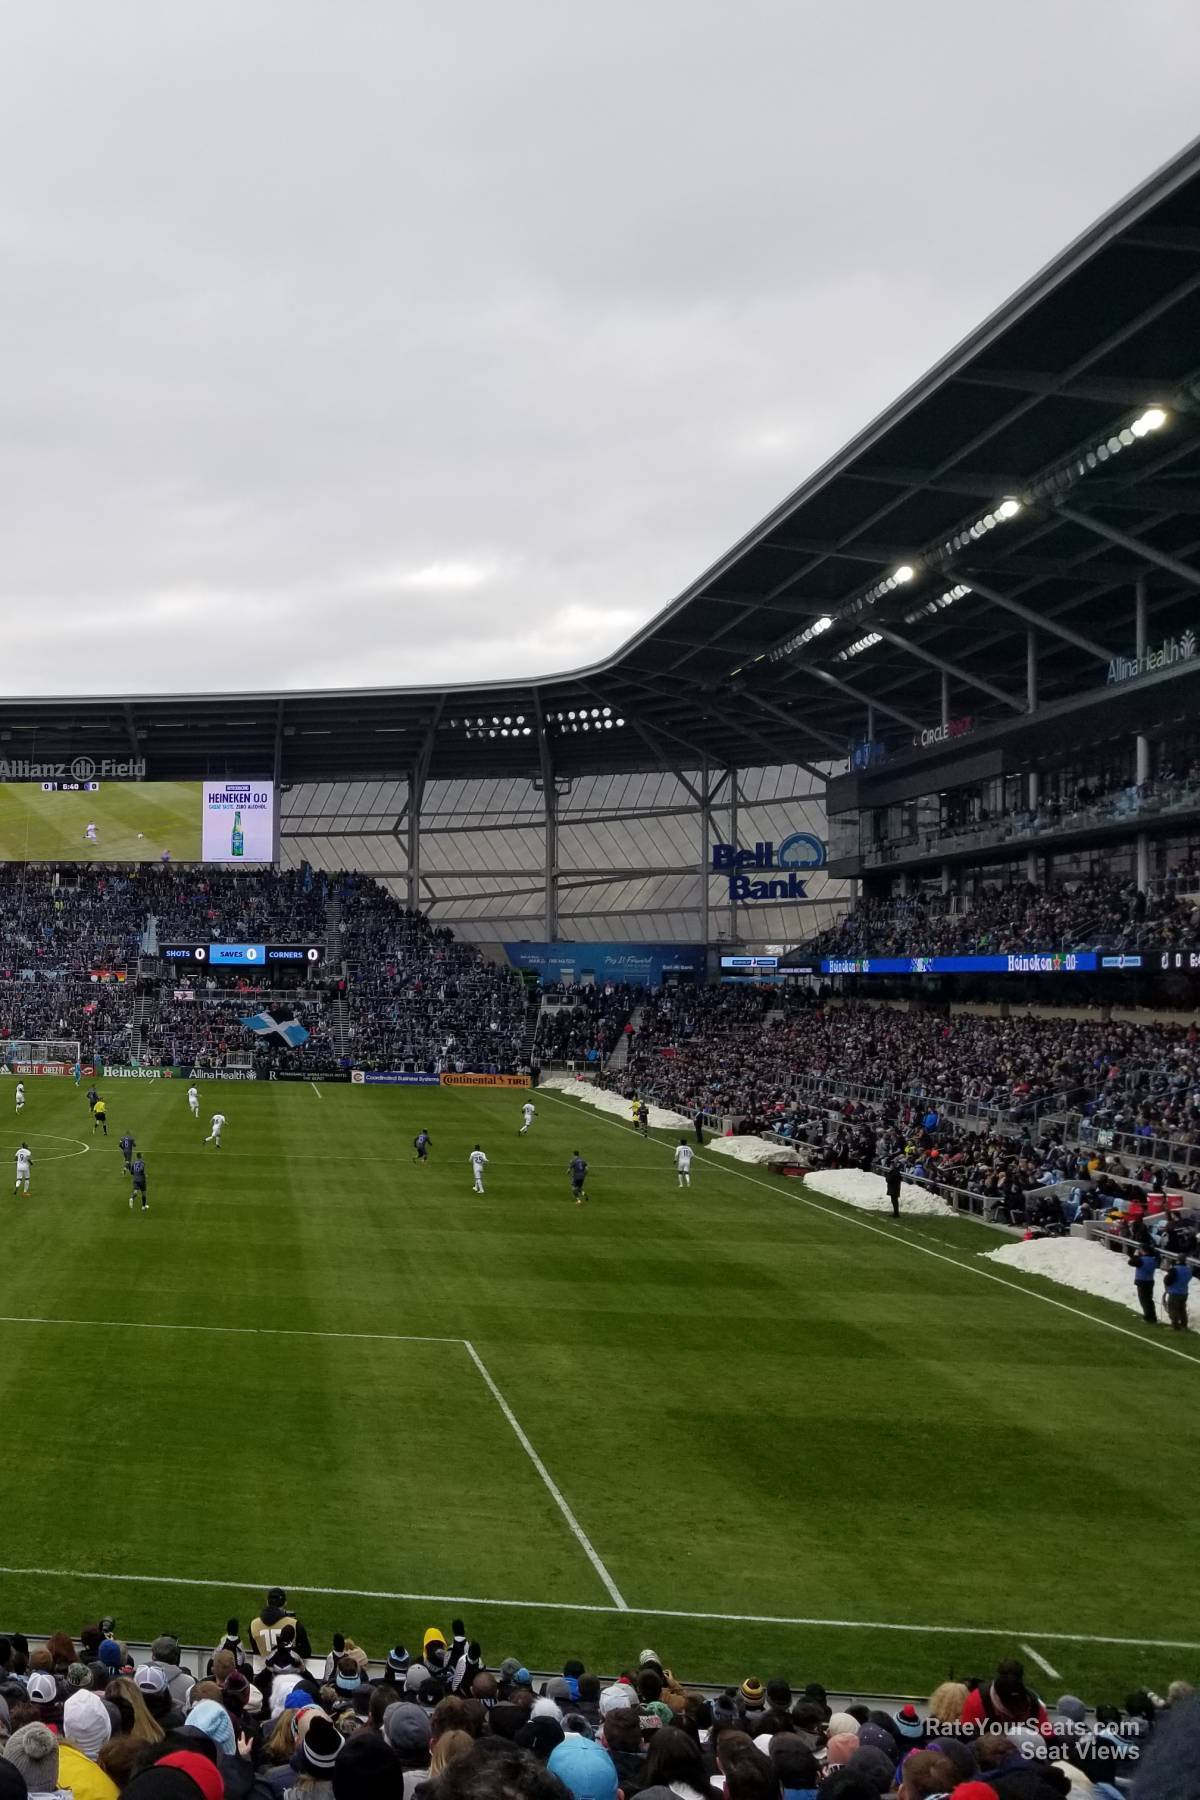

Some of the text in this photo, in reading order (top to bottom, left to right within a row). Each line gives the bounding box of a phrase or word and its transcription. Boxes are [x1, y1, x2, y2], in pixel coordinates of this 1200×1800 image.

[1106, 637, 1179, 685] Allina Health
[921, 724, 949, 746] CIRCLE
[102, 759, 146, 777] Field
[208, 793, 268, 803] HEINEKEN 0.0
[712, 842, 773, 869] Bell
[729, 873, 809, 900] Bank
[195, 948, 205, 959] 0
[246, 948, 257, 960] 0
[269, 949, 318, 960] CORNERS 0
[829, 961, 855, 973] Heineken
[1008, 955, 1052, 971] Heineken
[103, 1067, 161, 1078] Heineken
[189, 1068, 246, 1080] Allina Health
[269, 1070, 278, 1080] R
[442, 1074, 496, 1086] Continental
[19, 1153, 24, 1162] 9
